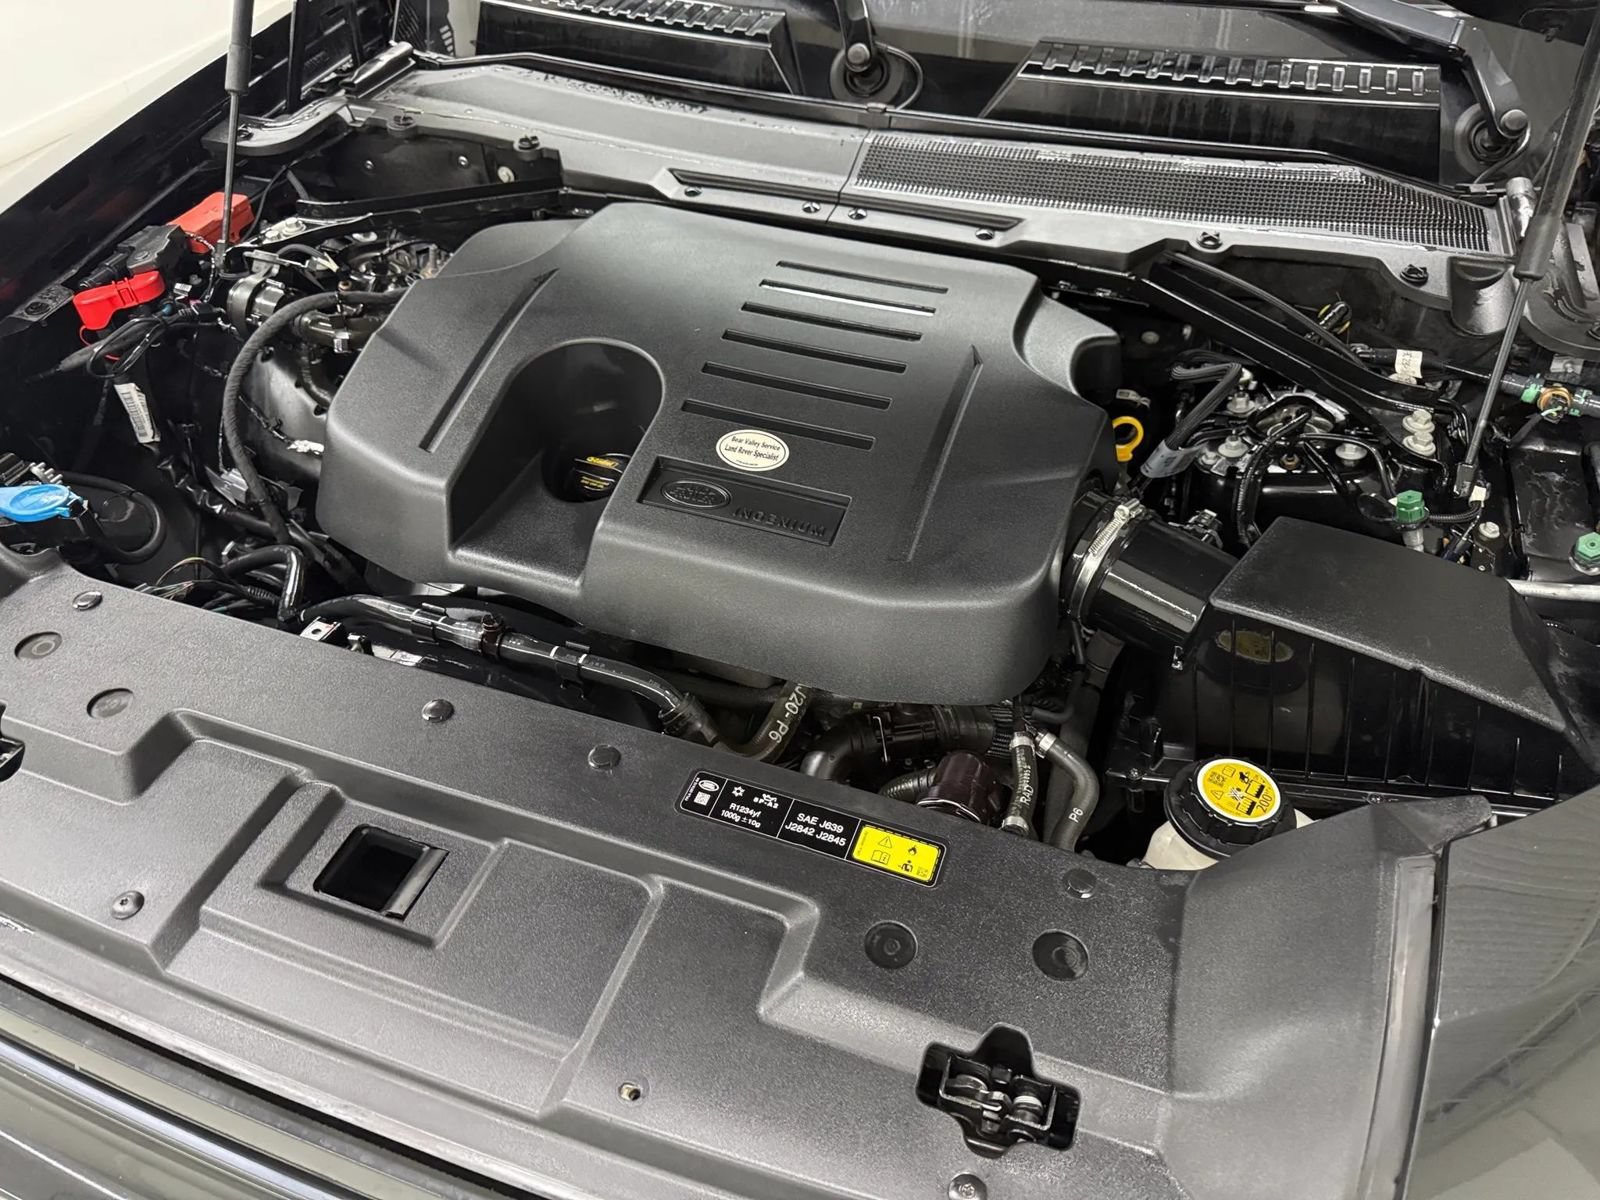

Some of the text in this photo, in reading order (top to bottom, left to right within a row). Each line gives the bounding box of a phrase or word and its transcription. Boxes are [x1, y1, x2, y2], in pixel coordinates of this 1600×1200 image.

[724, 444, 780, 461] Land Rover Specialist
[731, 435, 781, 451] Bear Valley Service
[731, 506, 826, 537] INGENIUM
[1019, 785, 1034, 805] RAD
[720, 809, 762, 829] 1000g ±10g
[729, 802, 762, 818] R1234yf
[1068, 807, 1084, 823] P6
[796, 811, 845, 834] SAE J639
[784, 820, 815, 837] J2842
[815, 830, 847, 847] J2845
